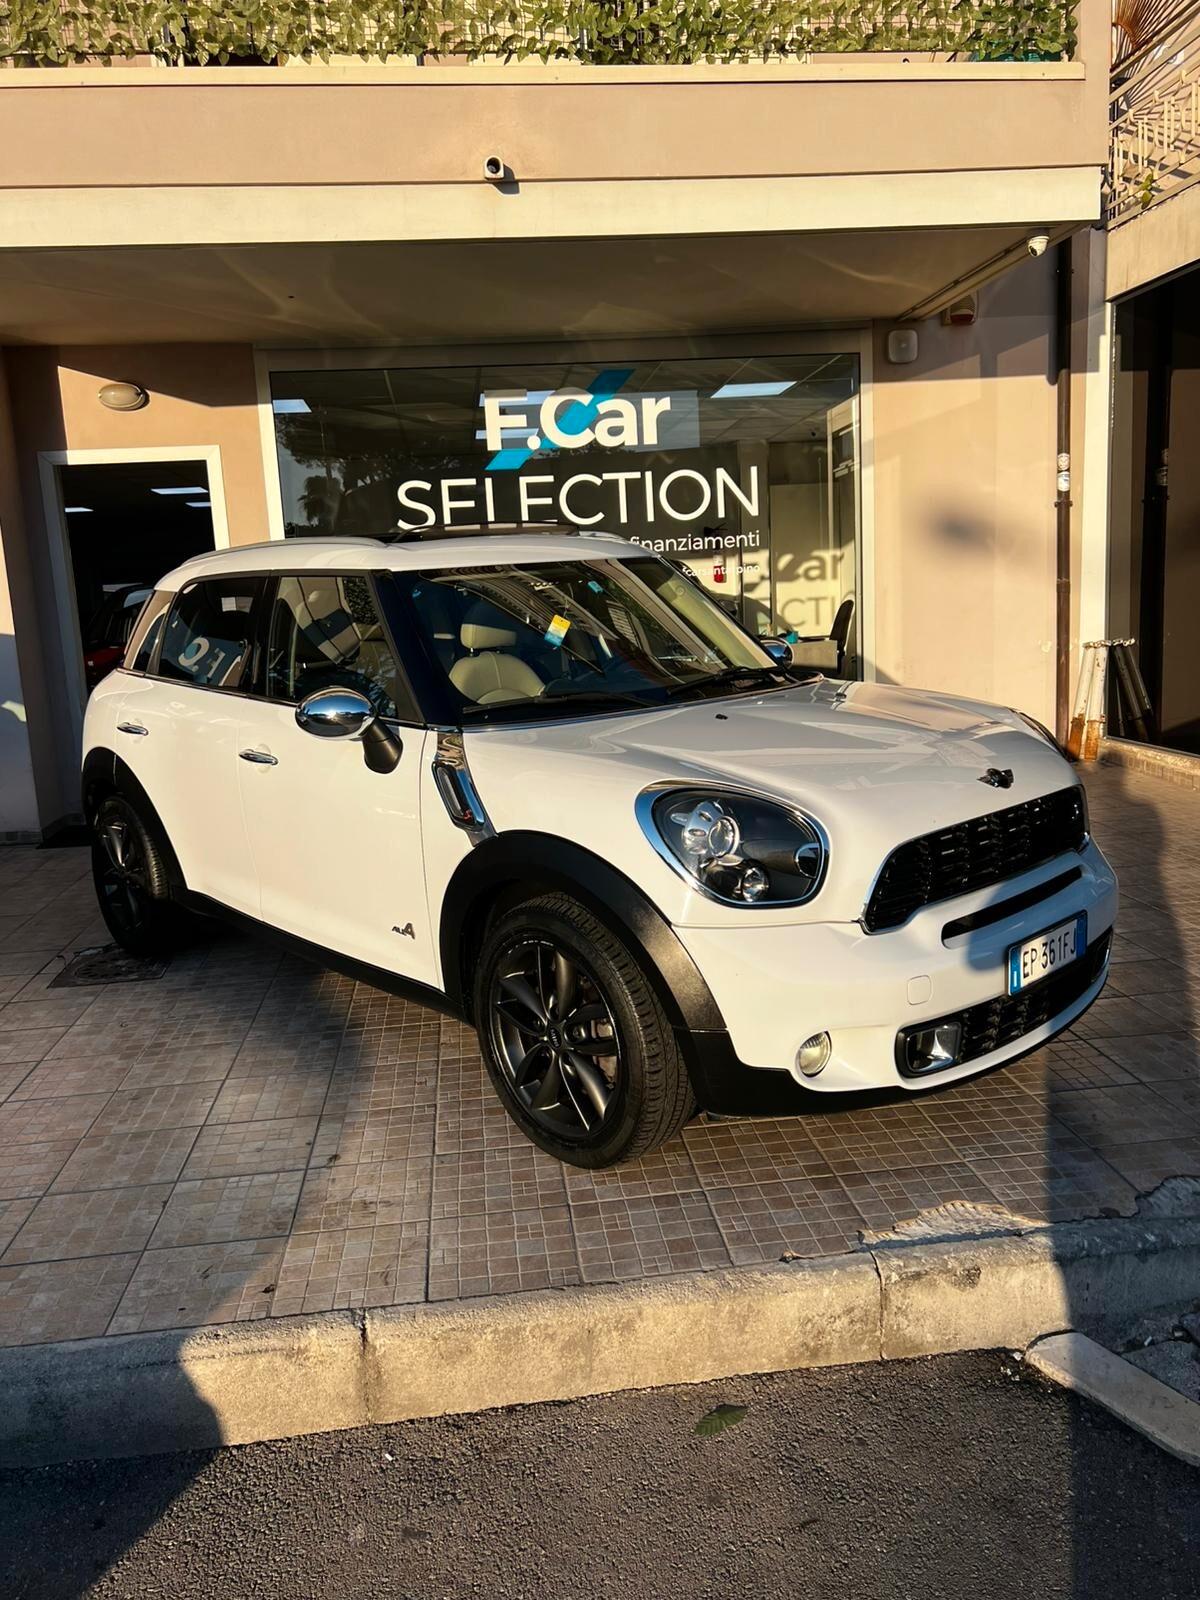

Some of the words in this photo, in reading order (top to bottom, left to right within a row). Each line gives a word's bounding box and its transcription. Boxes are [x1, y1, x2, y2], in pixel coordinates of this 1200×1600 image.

[484, 387, 672, 451] F.Car
[397, 465, 759, 532] SELECTION
[630, 530, 760, 552] finanziamenti
[1023, 947, 1038, 979] EP
[1041, 927, 1077, 969] 361FJ
